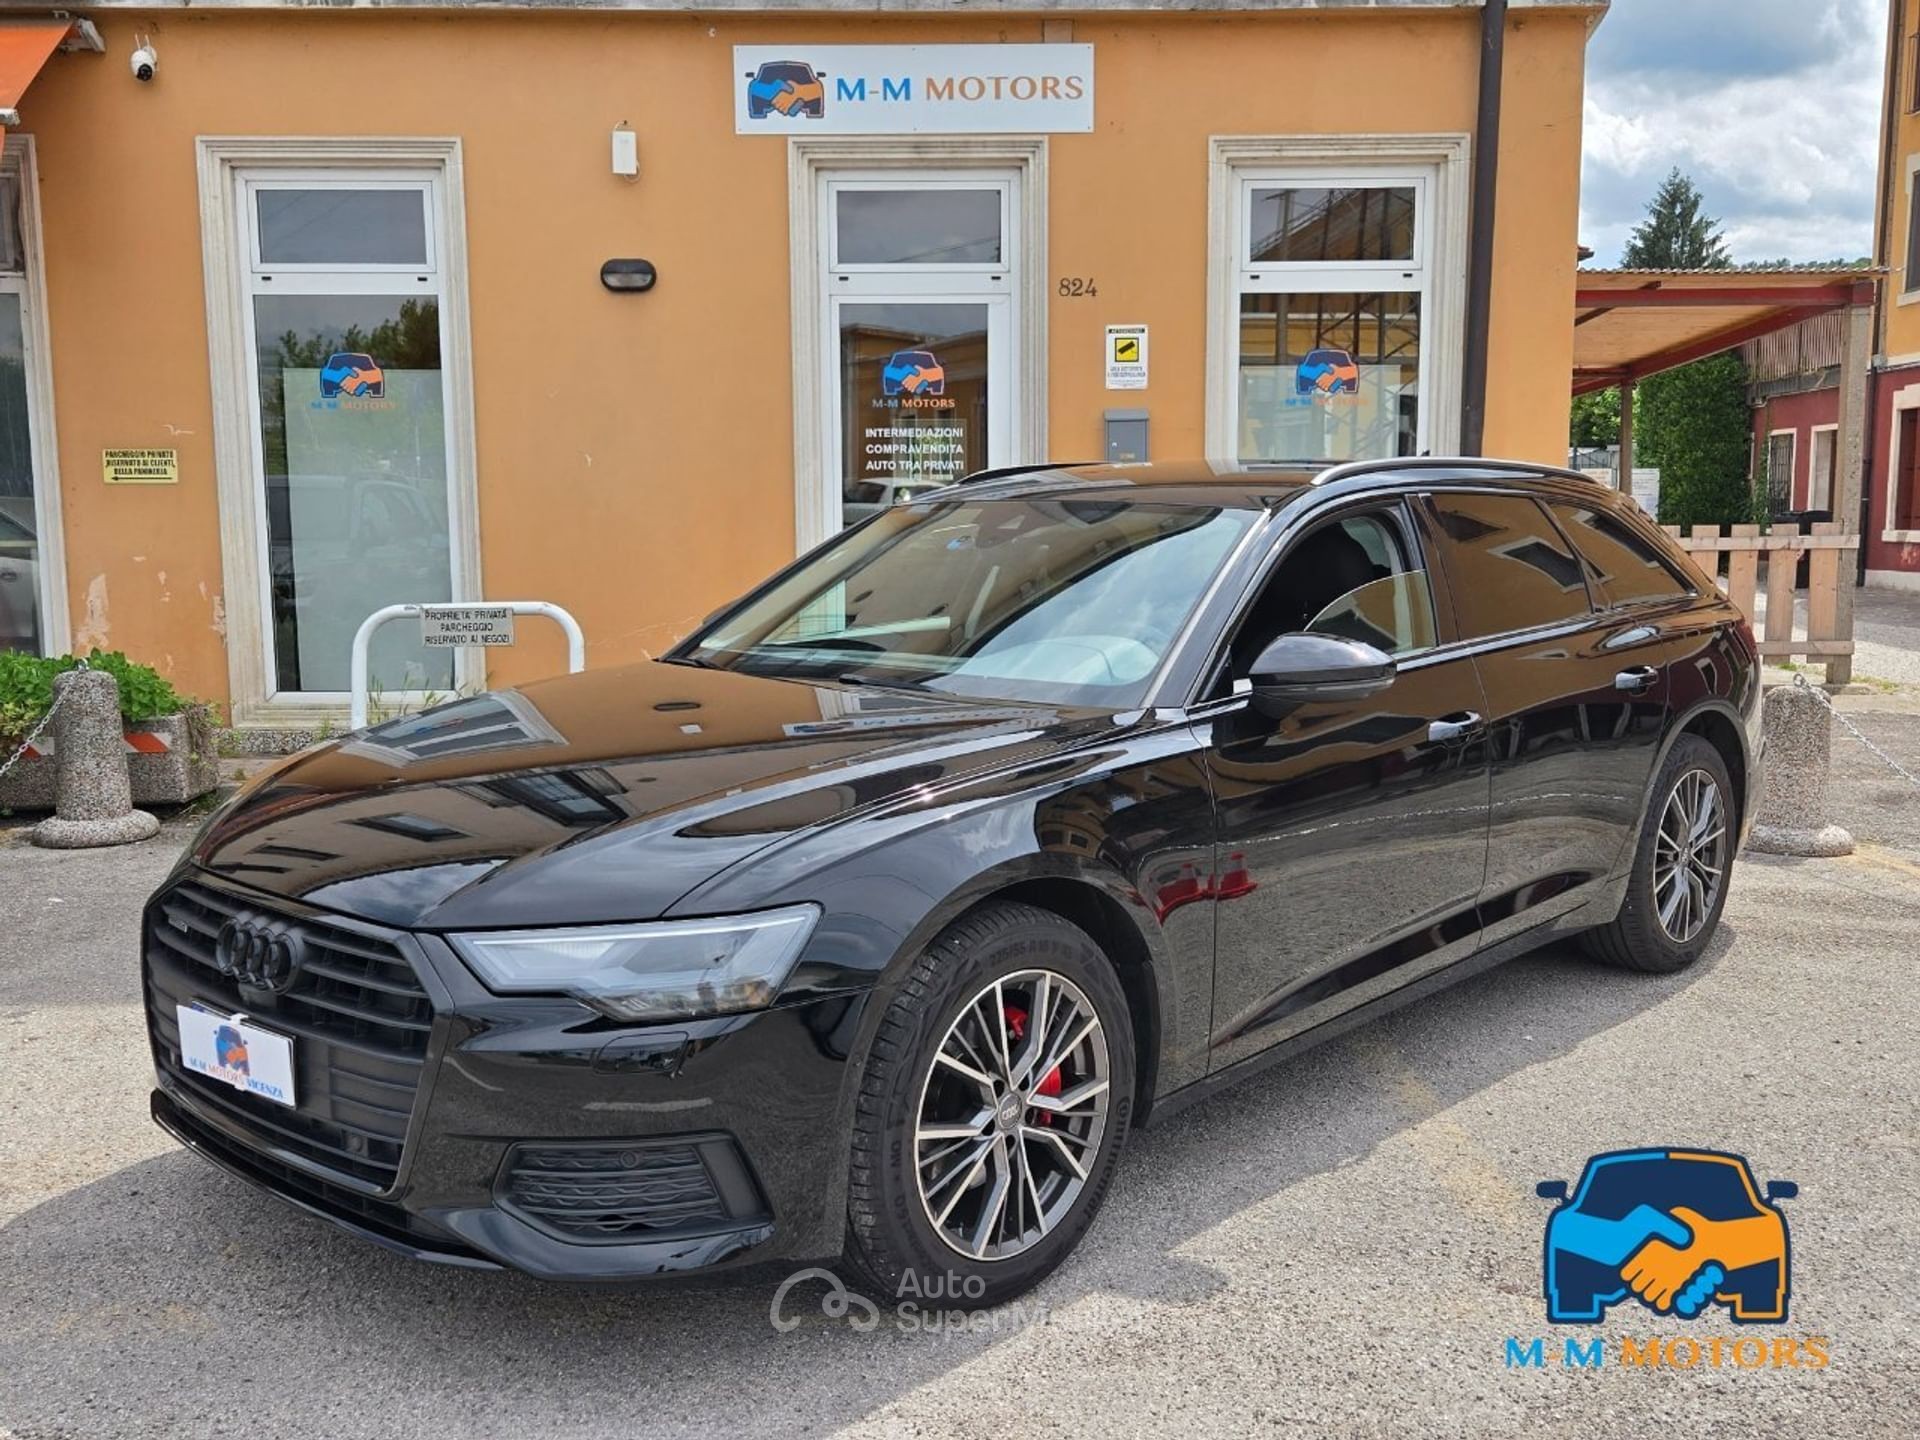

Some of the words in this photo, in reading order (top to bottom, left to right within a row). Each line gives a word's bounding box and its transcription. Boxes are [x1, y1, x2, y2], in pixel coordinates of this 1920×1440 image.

[836, 78, 911, 101] M-M
[926, 76, 1084, 101] MOTORS
[1059, 277, 1098, 297] 824
[872, 399, 898, 408] M-M
[901, 399, 956, 408] MOTORS
[865, 428, 963, 438] INTERMEDIAZIONI
[865, 444, 963, 454] COMPRAVENDITA
[865, 460, 897, 470] AUTO
[899, 461, 920, 470] TRA
[923, 461, 964, 470] PRIVATI
[441, 622, 493, 632] PARCHEGGIO
[425, 634, 467, 645] RISERVATO
[481, 634, 509, 643] NEGOZI
[247, 1078, 284, 1098] VICENZA
